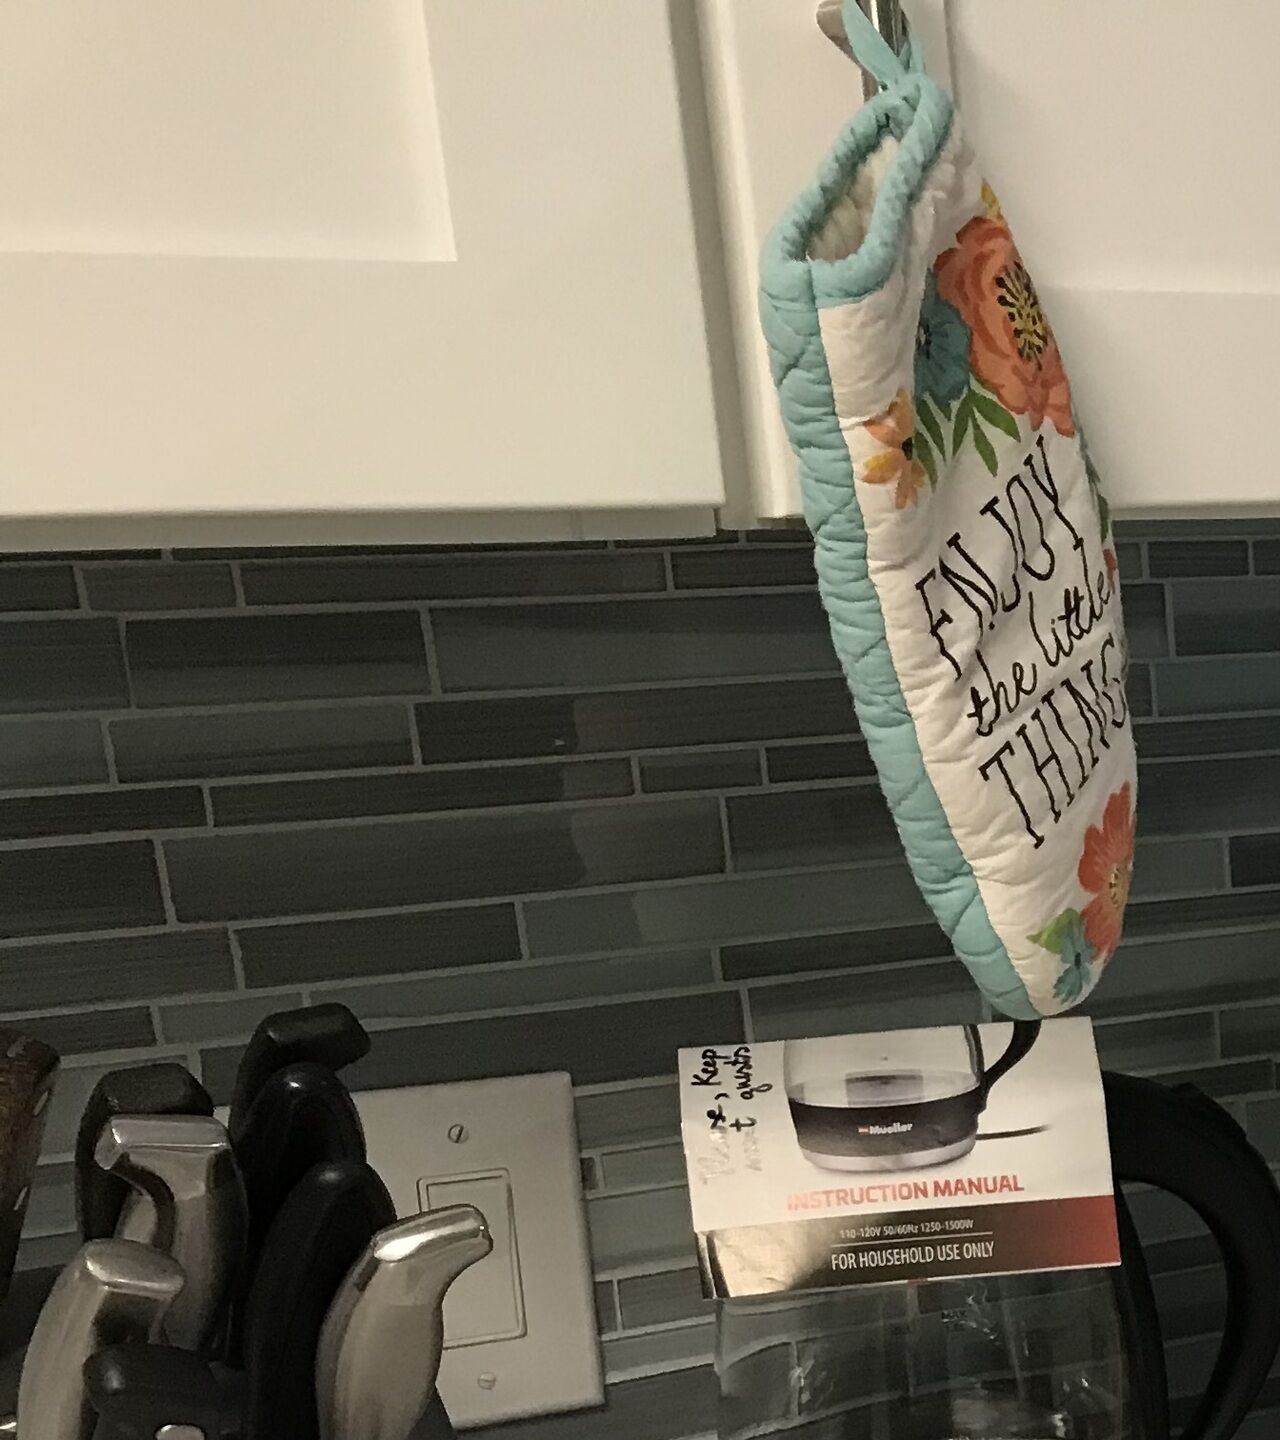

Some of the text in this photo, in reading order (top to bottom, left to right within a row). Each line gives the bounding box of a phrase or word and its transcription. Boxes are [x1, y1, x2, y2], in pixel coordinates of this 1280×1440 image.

[915, 434, 1085, 681] ENJOY
[967, 538, 1112, 738] the little
[691, 1048, 731, 1086] Keep
[869, 1121, 913, 1135] Mueller
[787, 1174, 1025, 1212] INSTRUCTION MANUAL
[831, 1240, 995, 1271] FOR HOUSEHOLD USE ONLY
